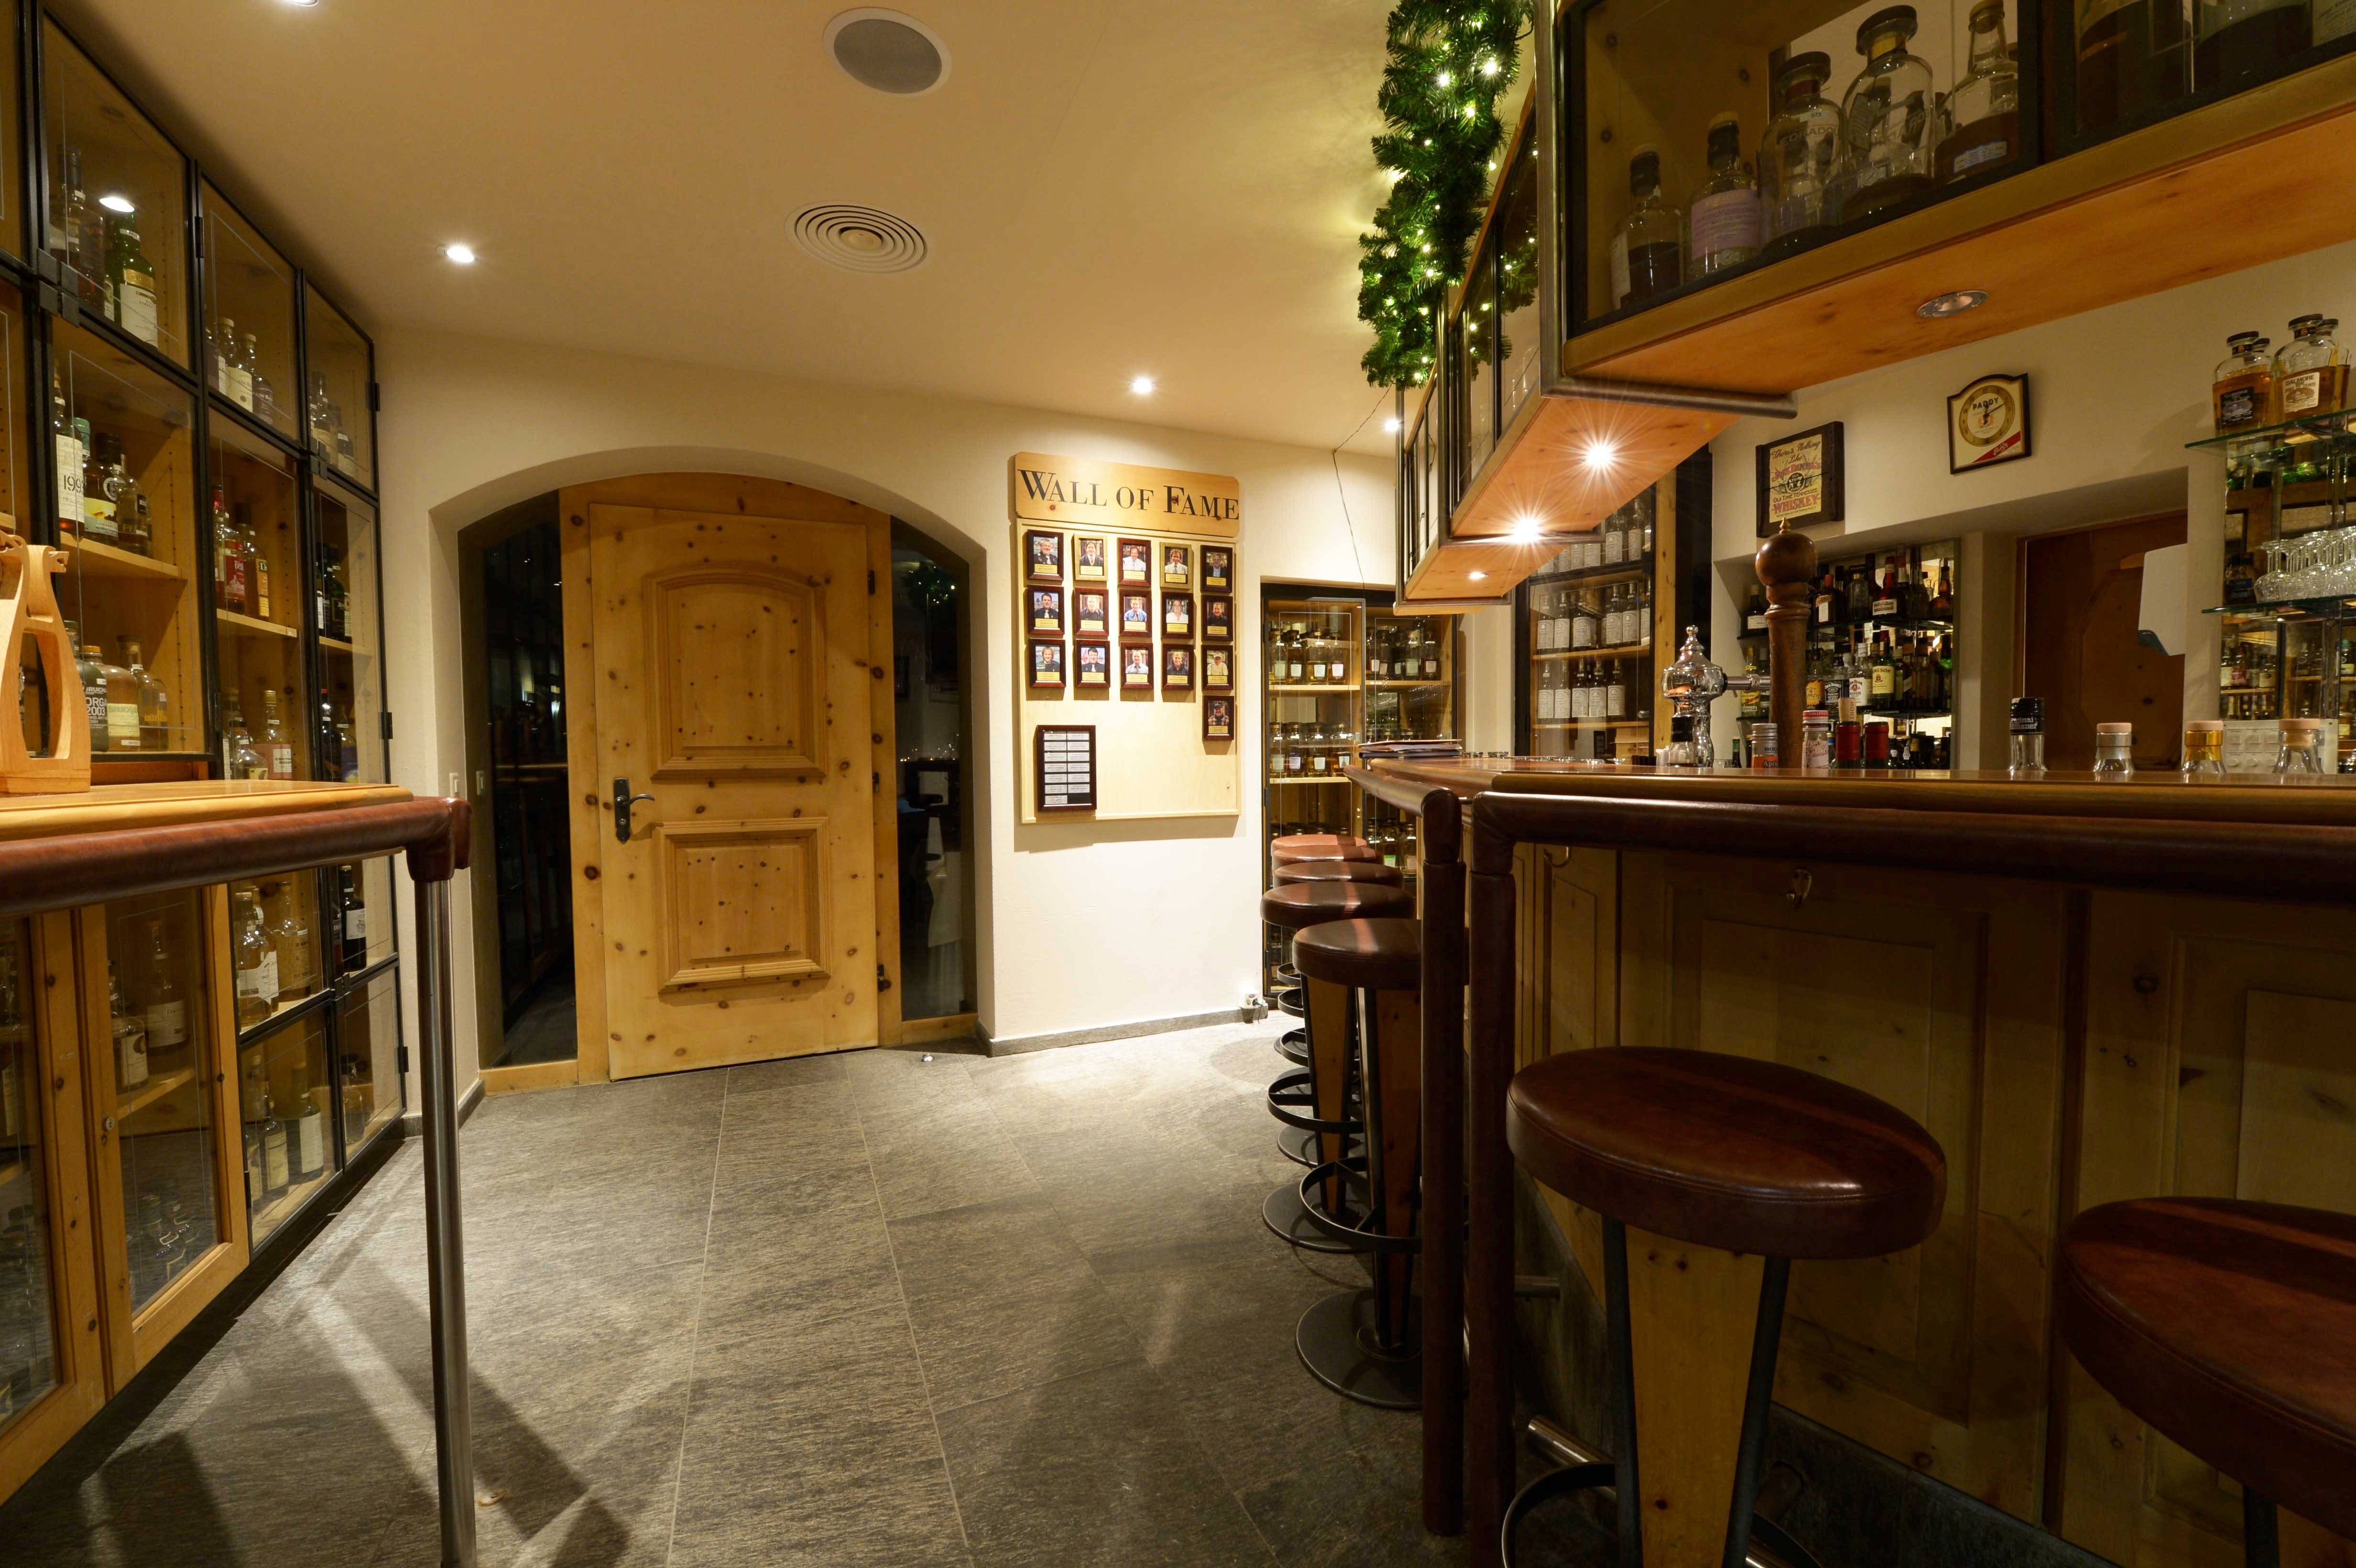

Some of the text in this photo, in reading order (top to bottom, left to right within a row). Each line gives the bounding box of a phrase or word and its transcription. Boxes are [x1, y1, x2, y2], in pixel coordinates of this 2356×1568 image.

[2285, 374, 2314, 386] DALMORE
[1973, 397, 1999, 410] PADDY
[1017, 468, 1239, 520] WALL OF FAME
[1773, 493, 1819, 514] WHISKEY
[87, 706, 105, 716] 2003
